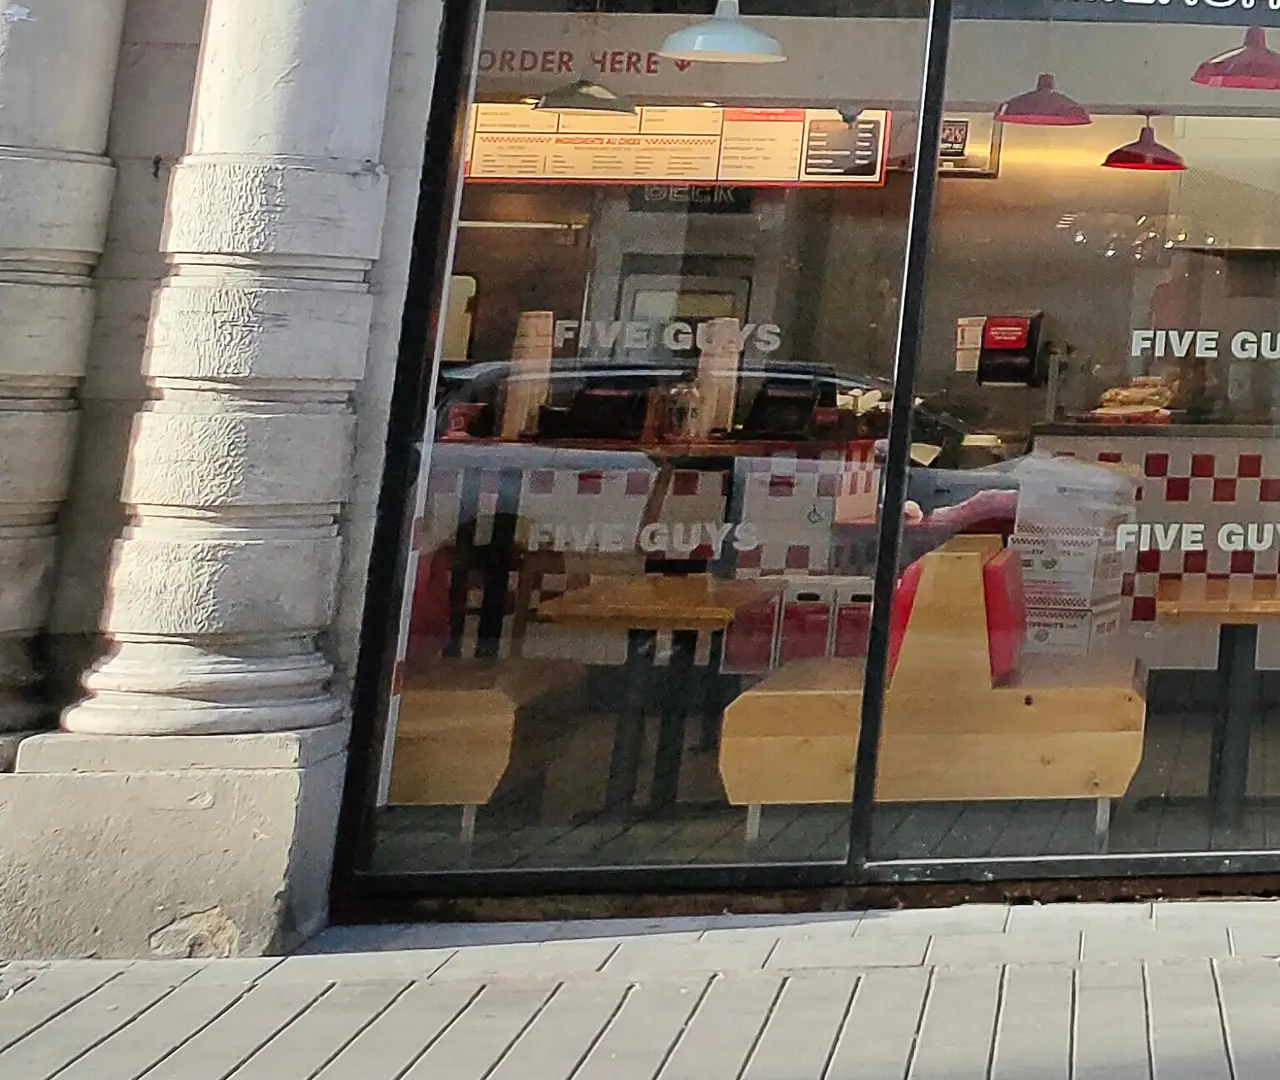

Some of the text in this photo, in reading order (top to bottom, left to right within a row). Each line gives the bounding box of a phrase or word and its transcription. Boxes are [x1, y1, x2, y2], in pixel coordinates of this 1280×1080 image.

[477, 49, 661, 74] ORDER HERE
[553, 319, 781, 352] FIVE GUYS
[1131, 330, 1219, 359] FIVE
[529, 522, 761, 555] FIVE GUYS
[1115, 523, 1205, 552] FIVE
